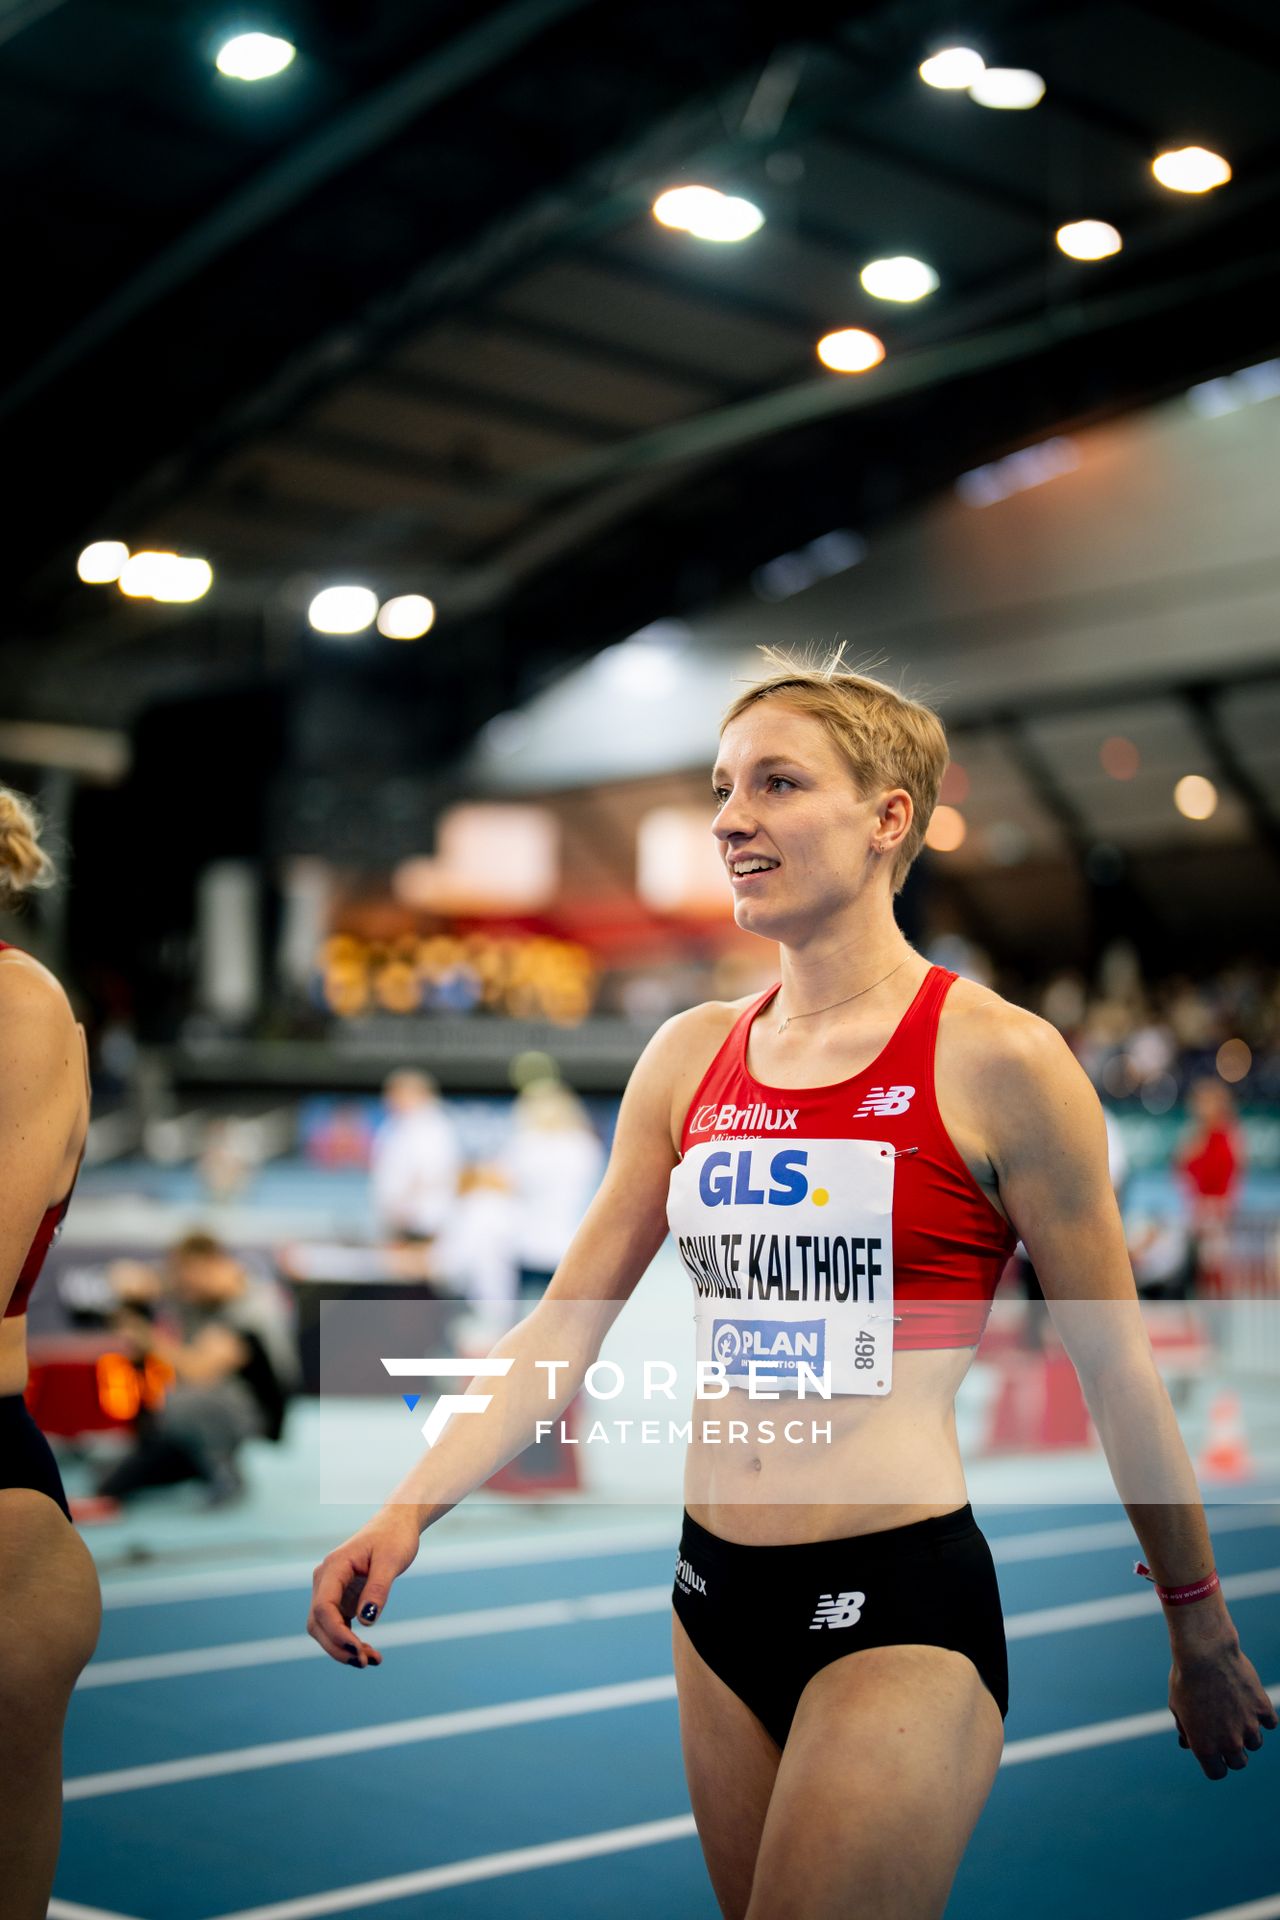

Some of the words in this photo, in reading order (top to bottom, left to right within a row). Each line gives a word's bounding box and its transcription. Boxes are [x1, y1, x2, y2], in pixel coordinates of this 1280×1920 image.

[715, 1103, 799, 1130] Brillux
[748, 1234, 882, 1303] KALTHOFF
[742, 1331, 818, 1357] PLAN
[855, 1330, 875, 1370] 498
